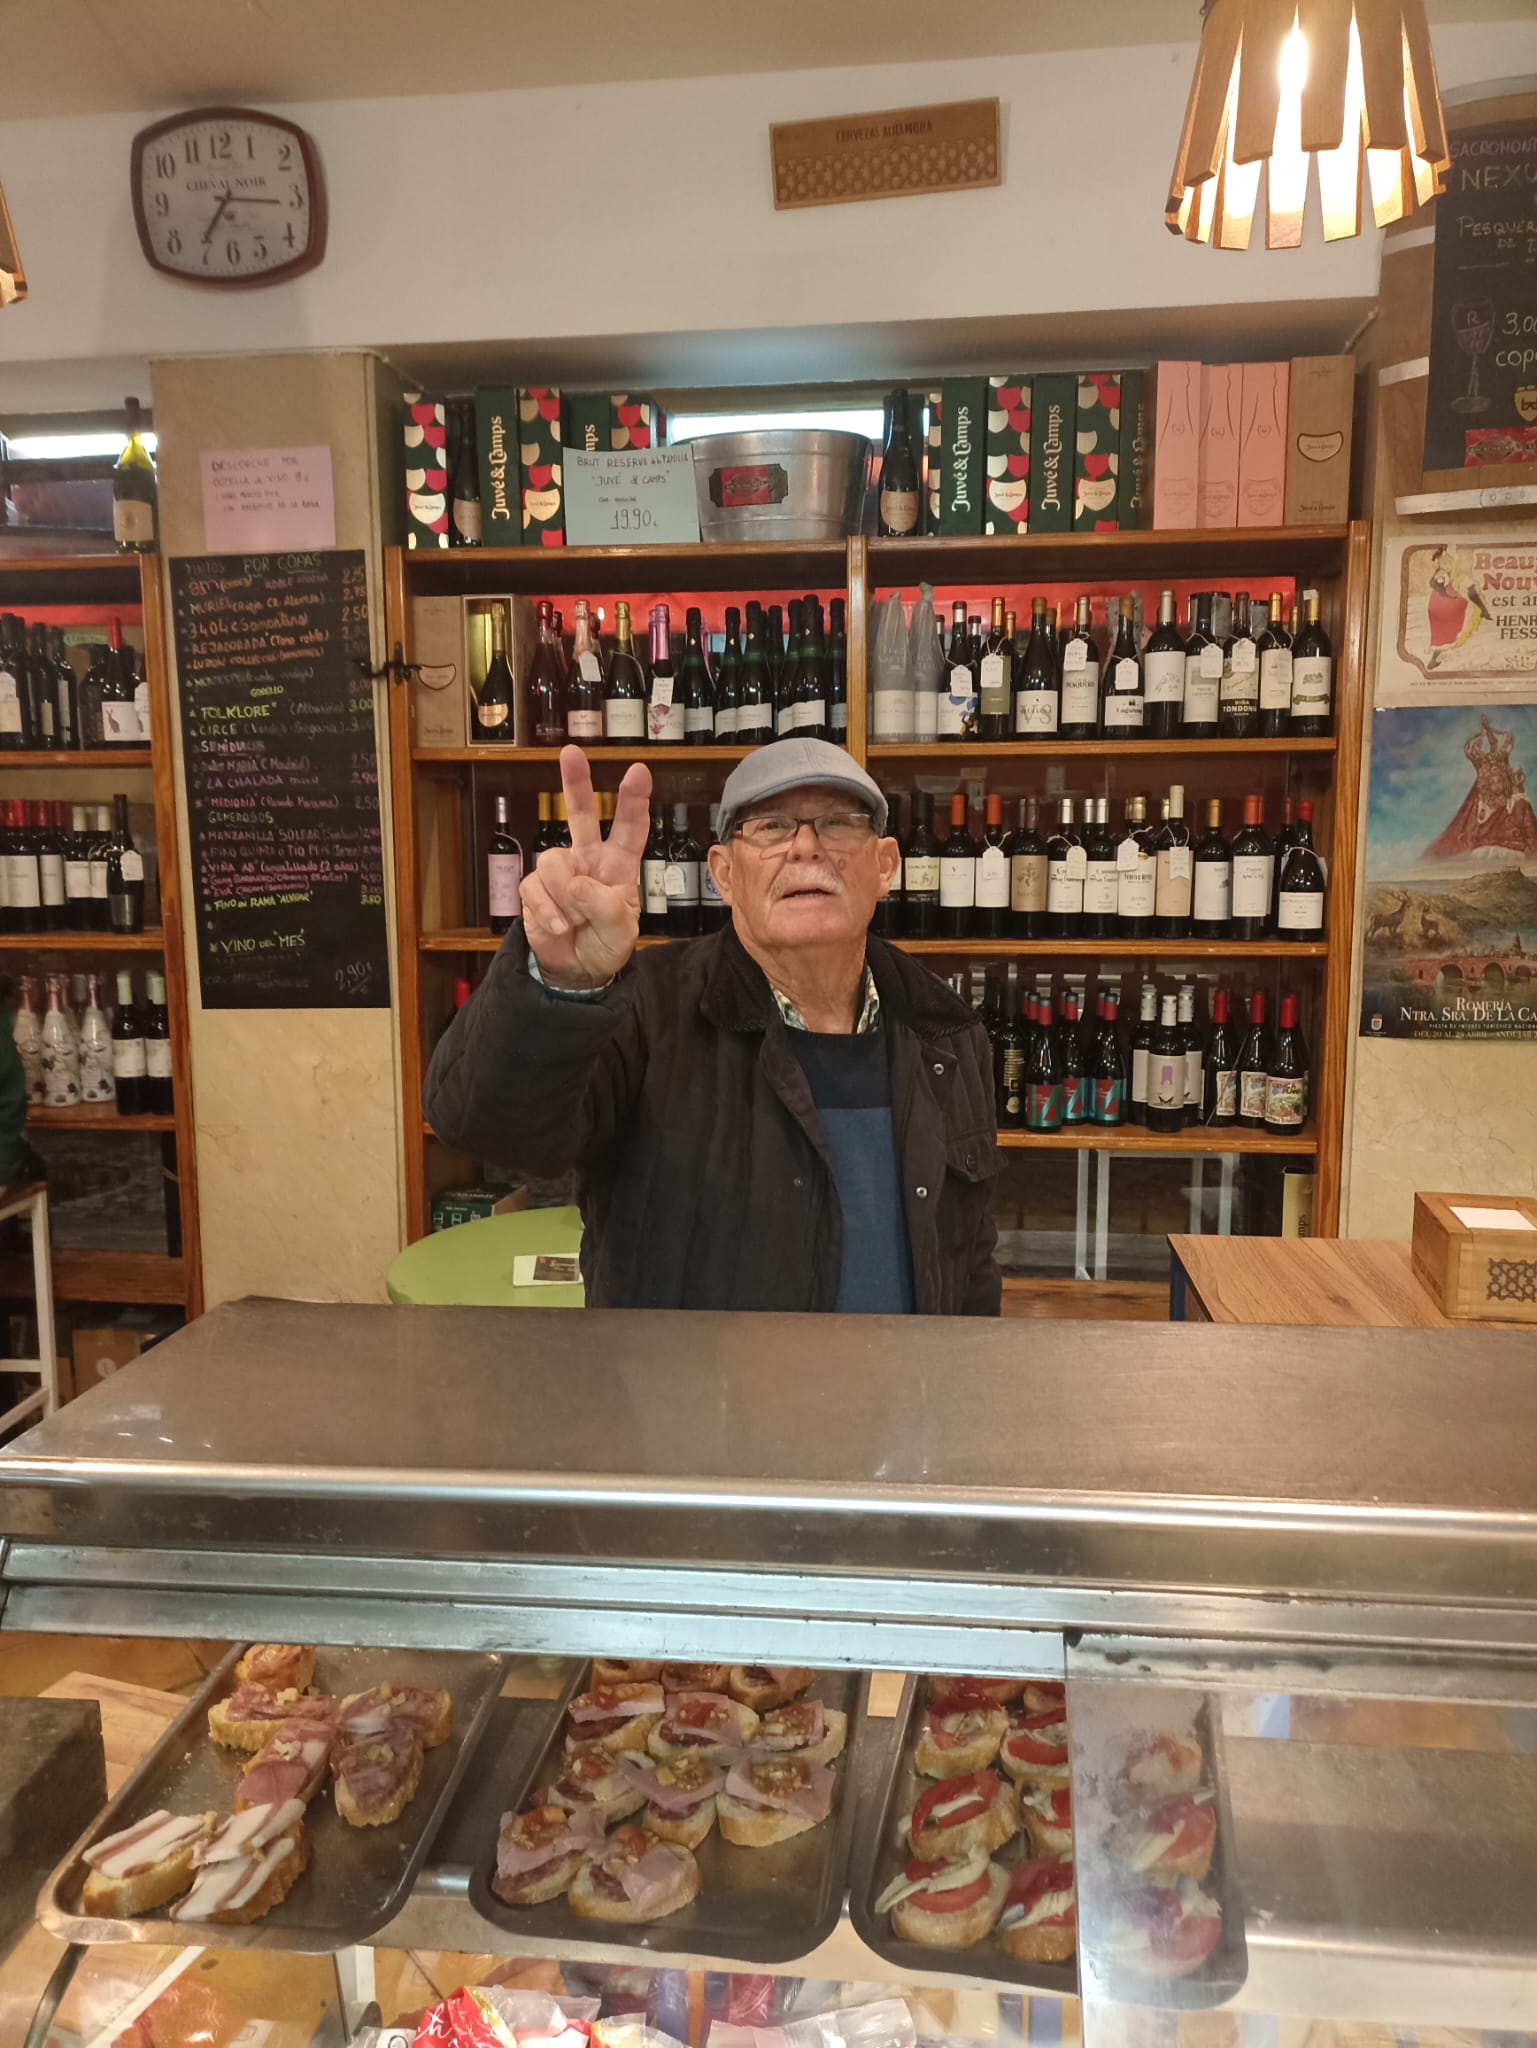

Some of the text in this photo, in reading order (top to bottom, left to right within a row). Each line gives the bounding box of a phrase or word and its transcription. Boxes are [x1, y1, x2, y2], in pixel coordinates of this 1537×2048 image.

[184, 140, 201, 163] 11
[210, 132, 232, 159] 12
[247, 135, 255, 160] 1
[278, 143, 292, 171] 2
[155, 152, 176, 178] 10
[155, 192, 169, 217] 9
[289, 184, 303, 209] 3
[167, 229, 182, 255] 8
[253, 234, 267, 260] 5
[283, 222, 295, 249] 4
[226, 240, 241, 264] 6
[1496, 348, 1537, 373] cop
[585, 424, 599, 452] mps
[489, 416, 510, 520] Juvé & Camps
[952, 406, 972, 512] Juvé & Camps
[1042, 404, 1063, 510] Juvé & Camps
[1492, 594, 1517, 607] est
[200, 723, 237, 736] CIRCE
[220, 938, 256, 954] VINO
